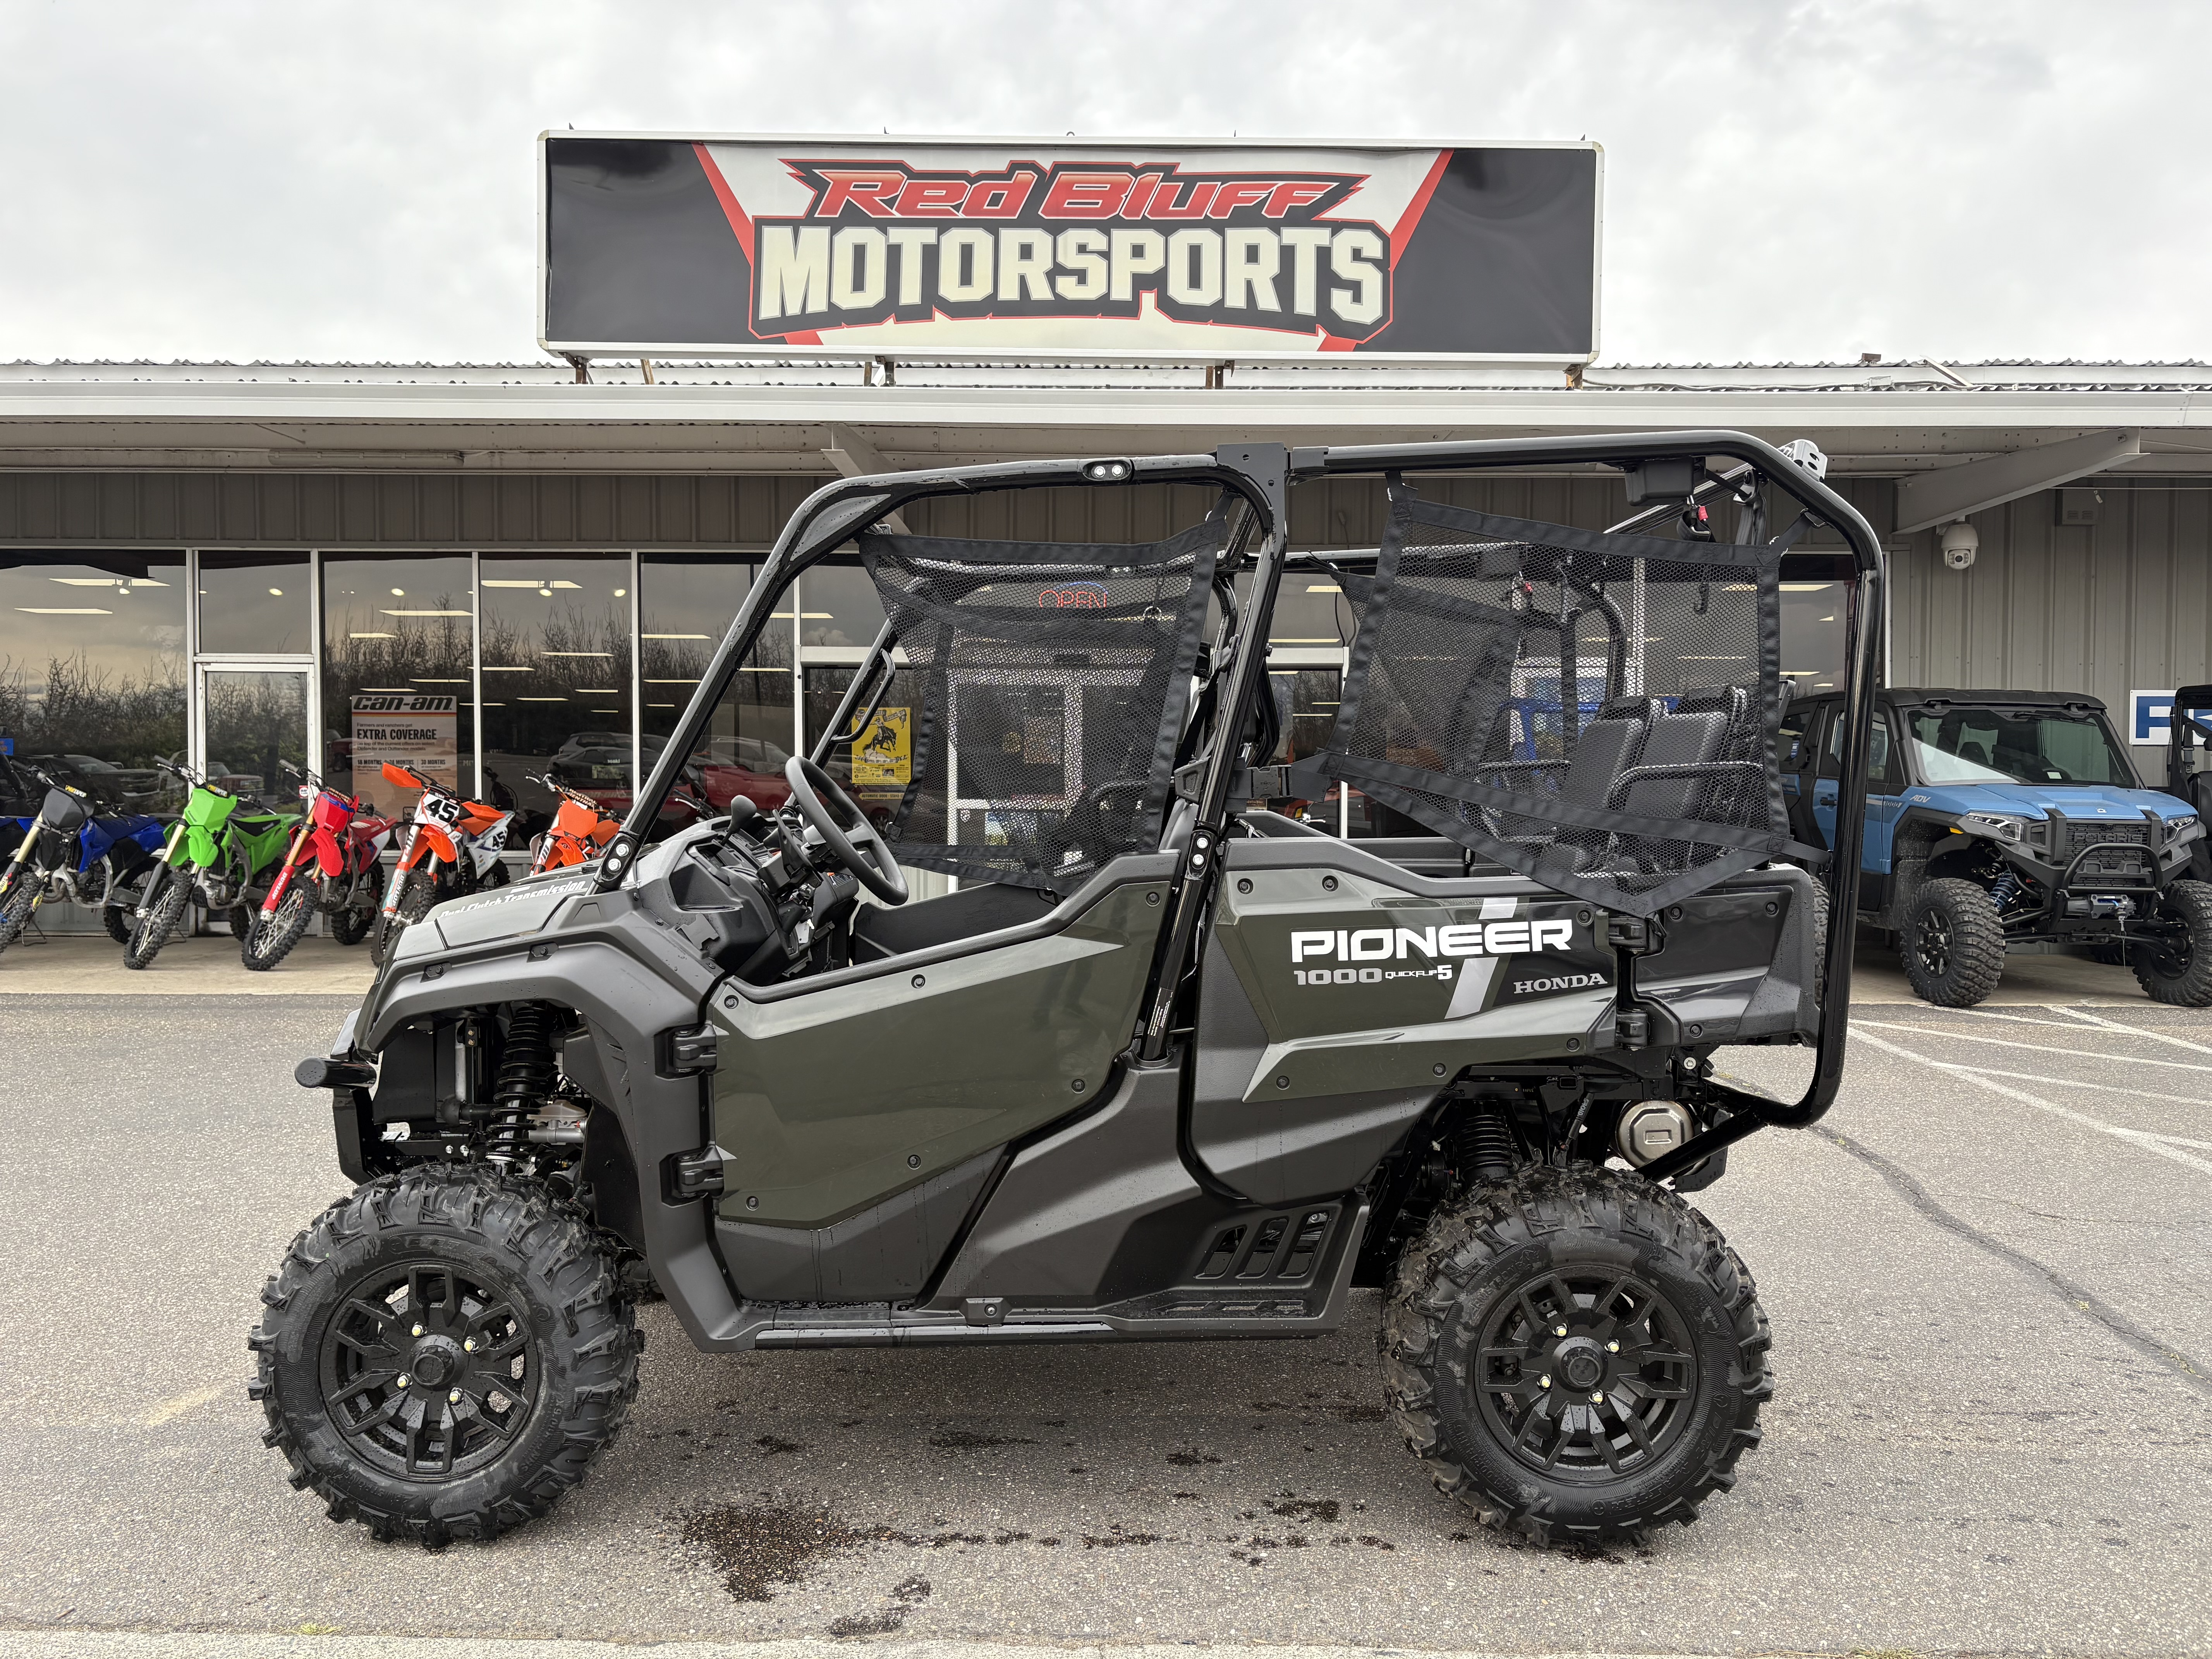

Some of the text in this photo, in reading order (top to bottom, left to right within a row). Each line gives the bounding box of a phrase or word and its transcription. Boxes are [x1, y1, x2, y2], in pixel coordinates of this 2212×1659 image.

[814, 170, 1339, 220] Red Bluff
[758, 226, 1384, 325] MOTORSPORTS
[353, 697, 452, 710] can-am
[357, 729, 437, 740] EXTRA COVERAGE
[1910, 795, 1931, 803] ADV
[427, 799, 458, 822] 45
[492, 831, 506, 848] 45
[2074, 834, 2142, 843] POLARIS
[272, 872, 287, 900] DUNLOP
[393, 874, 405, 907] DUNLOP
[467, 896, 502, 911] Clutch
[503, 881, 586, 903] Transmission
[1291, 919, 1573, 963] PIONEER
[1293, 968, 1382, 985] 1000
[1513, 973, 1608, 994] HONDA
[405, 1237, 462, 1251] DIRT
